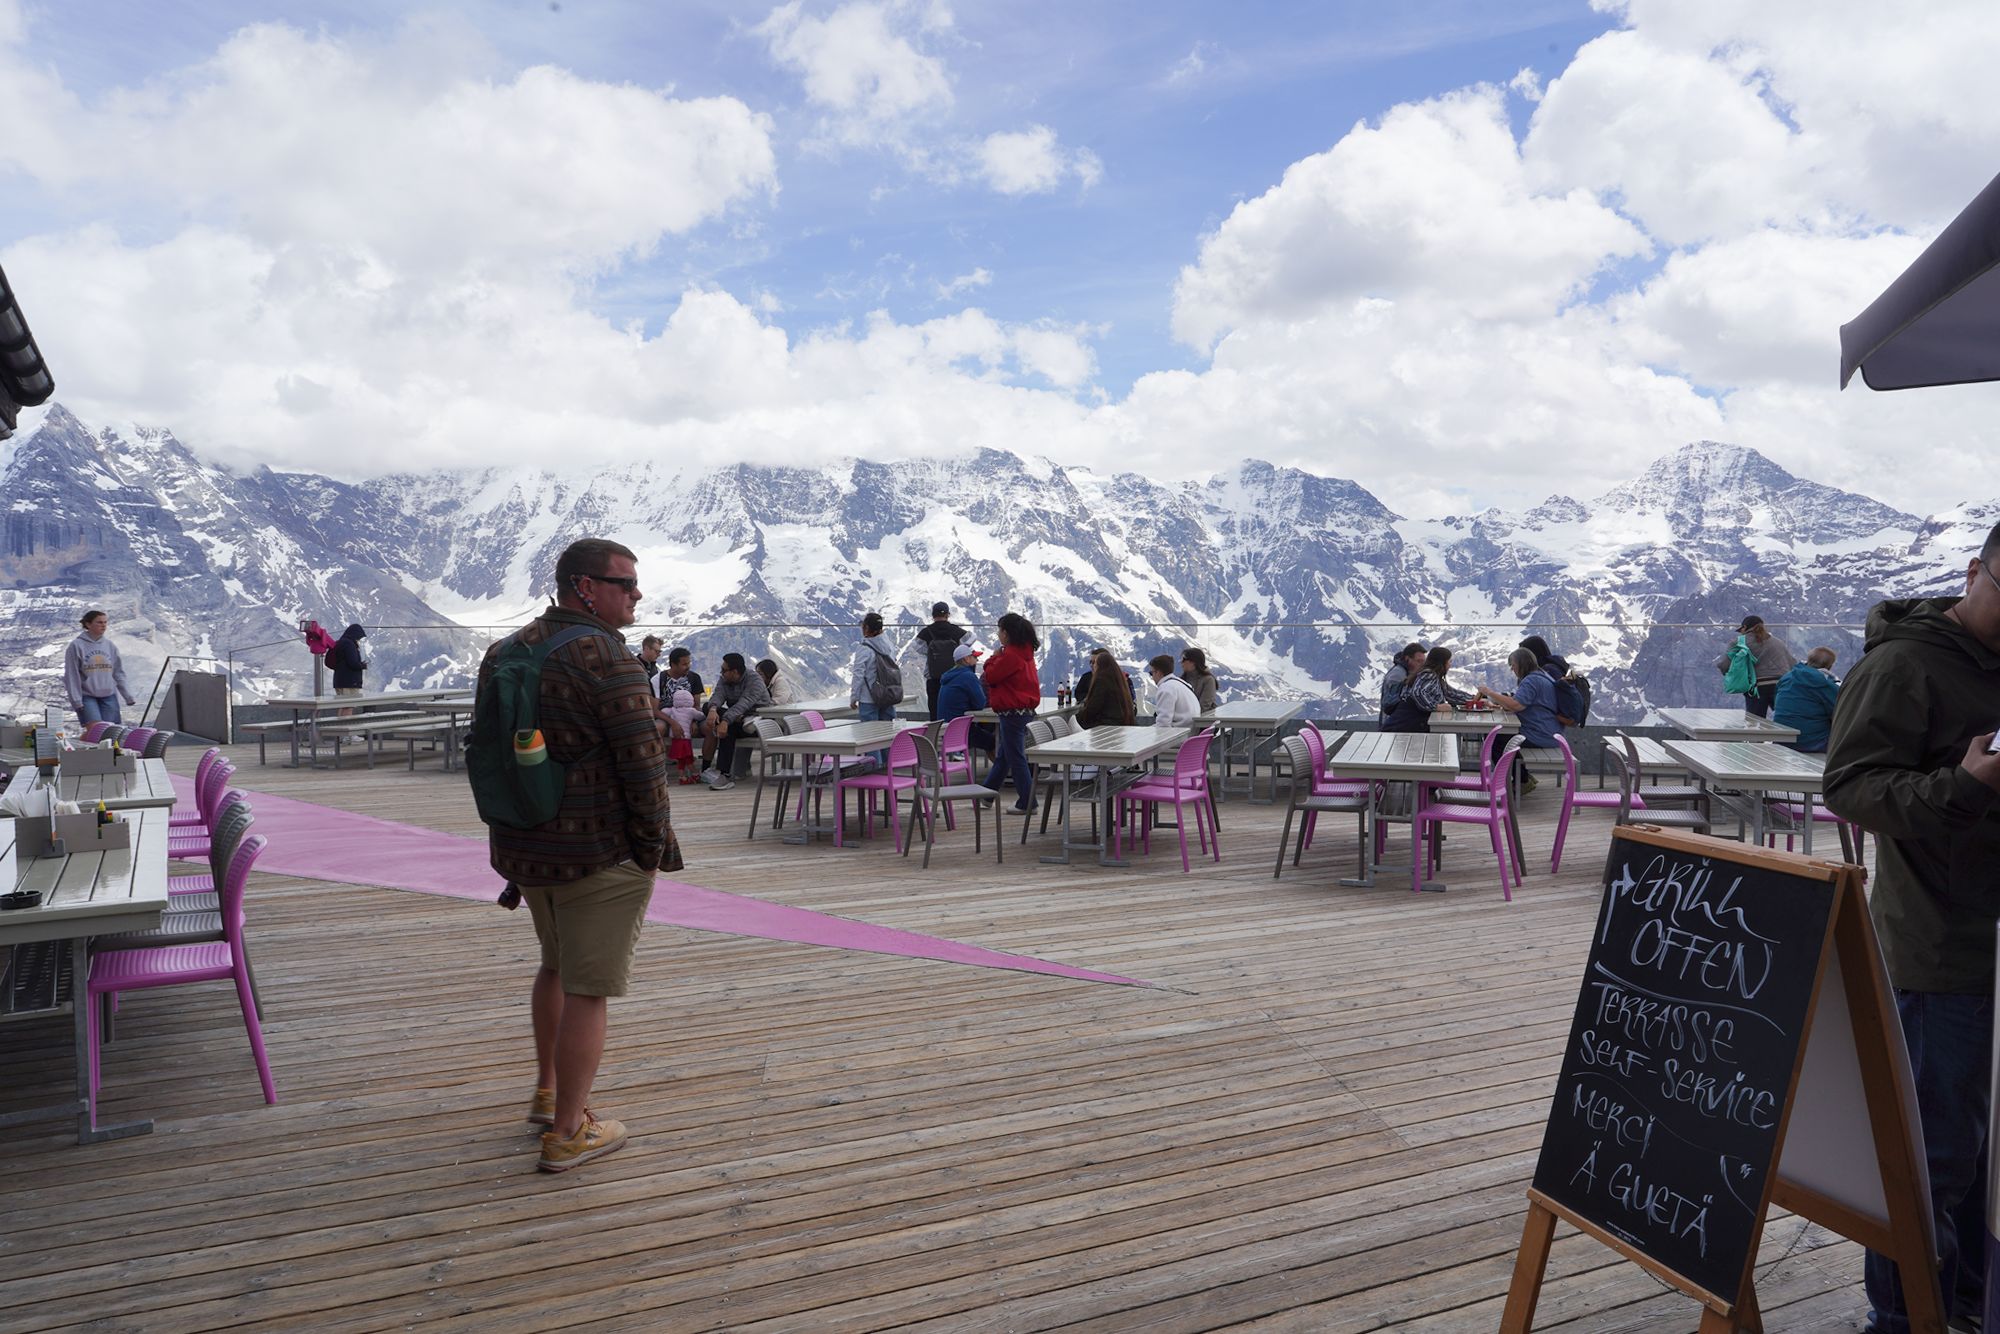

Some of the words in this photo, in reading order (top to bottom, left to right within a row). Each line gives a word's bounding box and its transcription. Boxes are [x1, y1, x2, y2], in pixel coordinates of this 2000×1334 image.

[1632, 855, 1781, 944] GRILL
[1631, 918, 1773, 999] OFFEN
[1592, 982, 1737, 1064] TERRASSE
[1573, 1083, 1656, 1159] MERCI
[1608, 1163, 1714, 1259] GUETÄ
